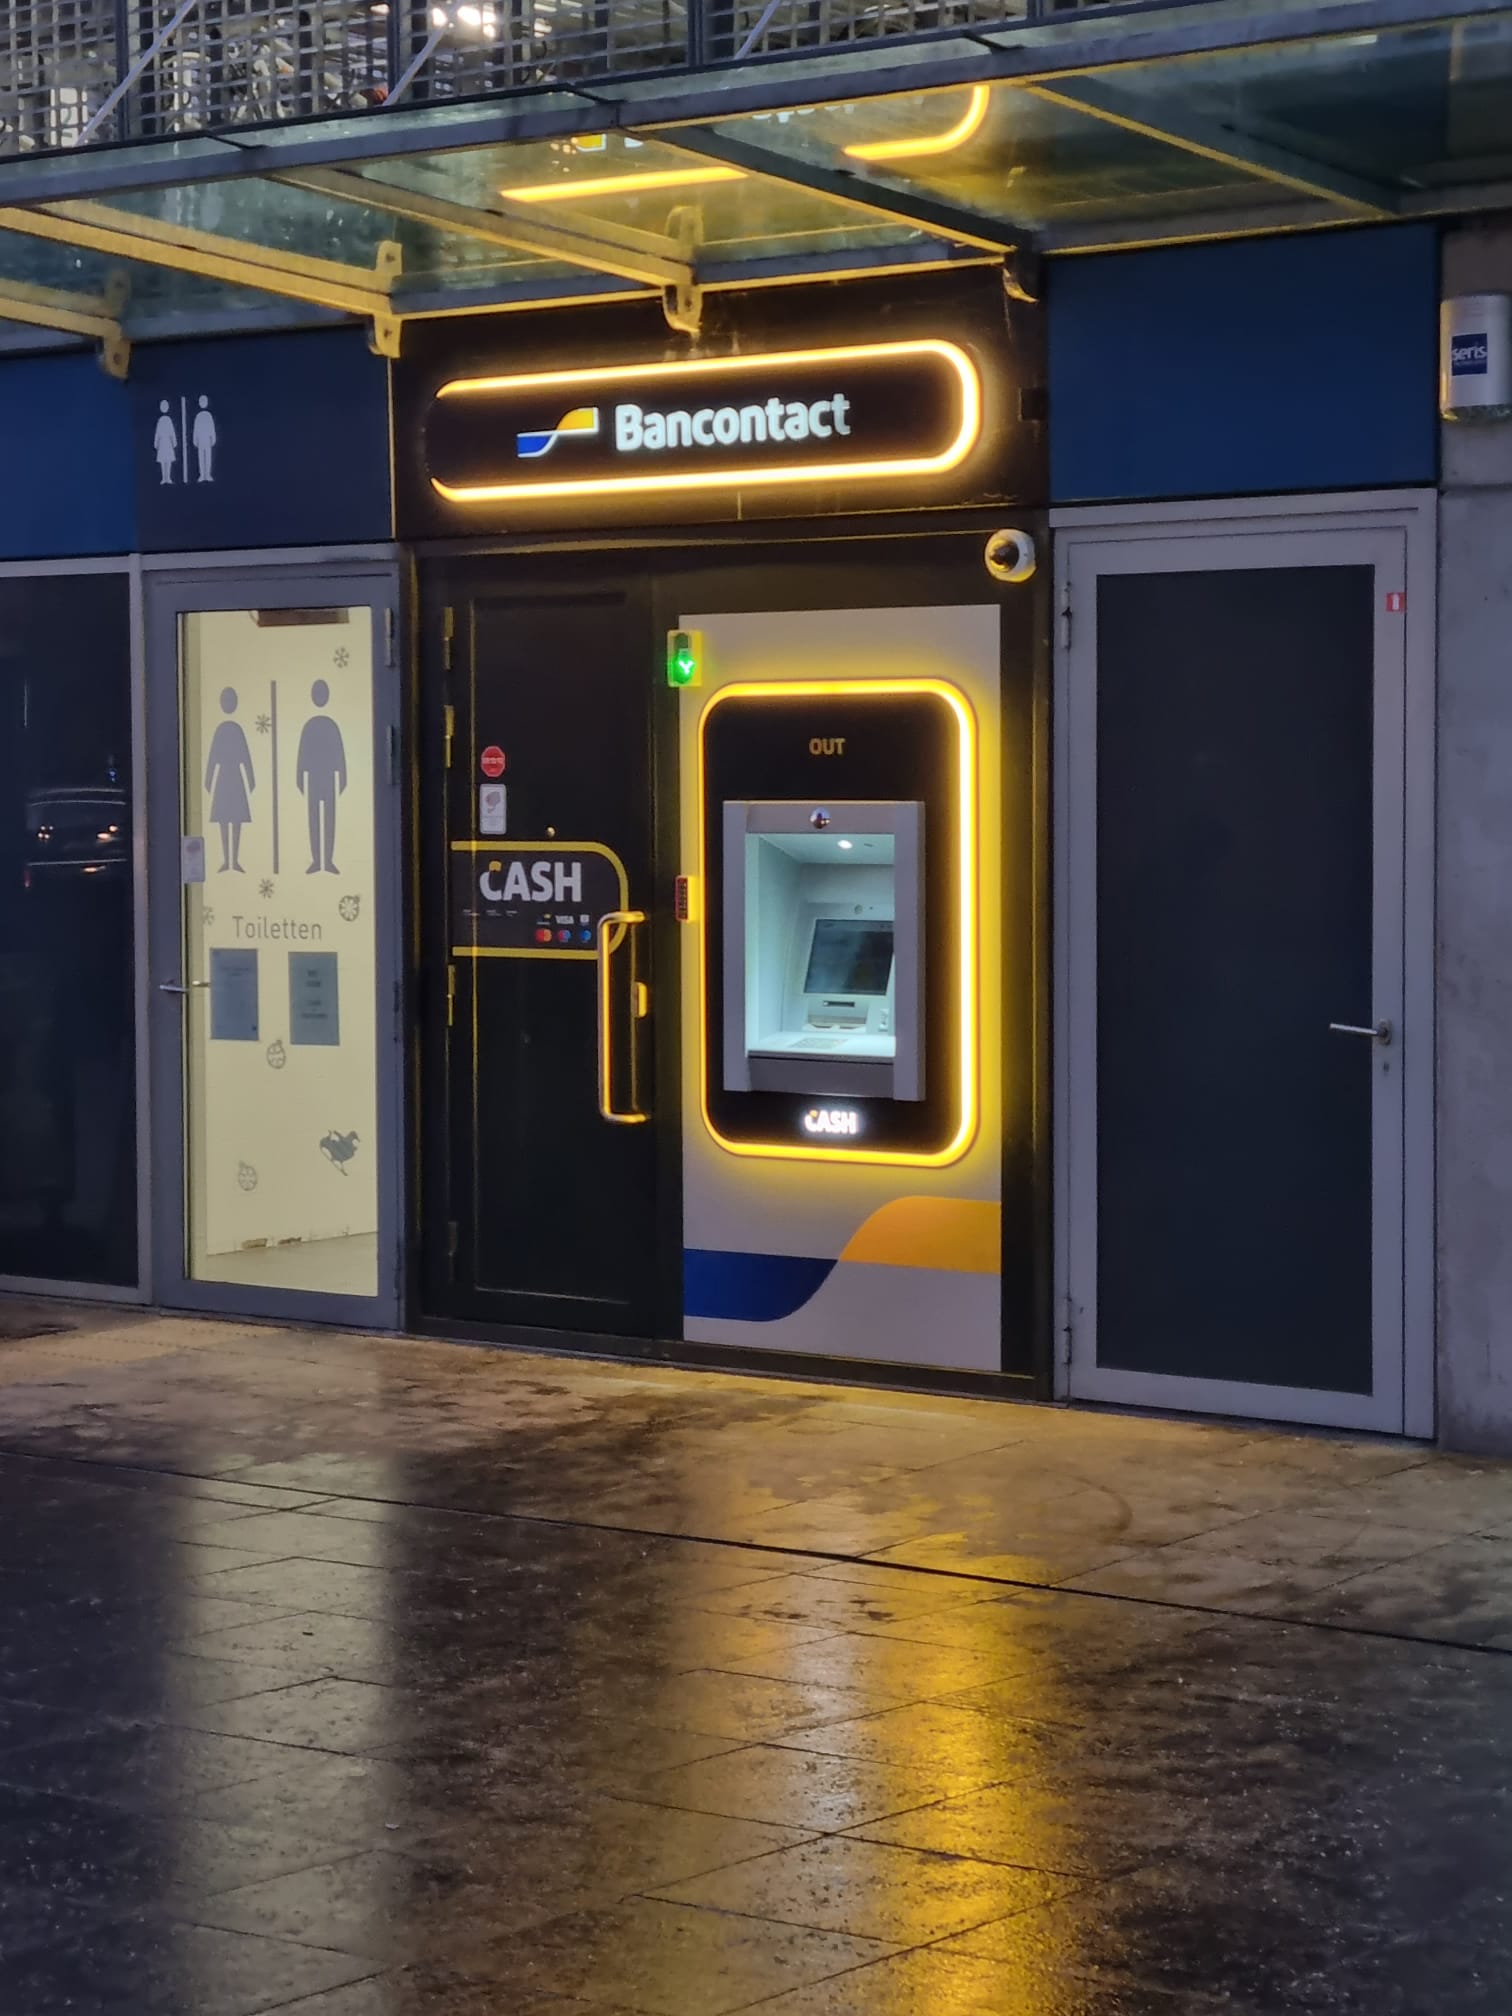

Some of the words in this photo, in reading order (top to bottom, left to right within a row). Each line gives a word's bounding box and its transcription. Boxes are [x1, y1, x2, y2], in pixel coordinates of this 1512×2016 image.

[1452, 345, 1487, 361] seris
[615, 393, 851, 451] Bancontact
[809, 737, 846, 756] OUT
[479, 861, 582, 902] CASH
[232, 915, 322, 940] Toiletten
[804, 1109, 858, 1134] CASH
